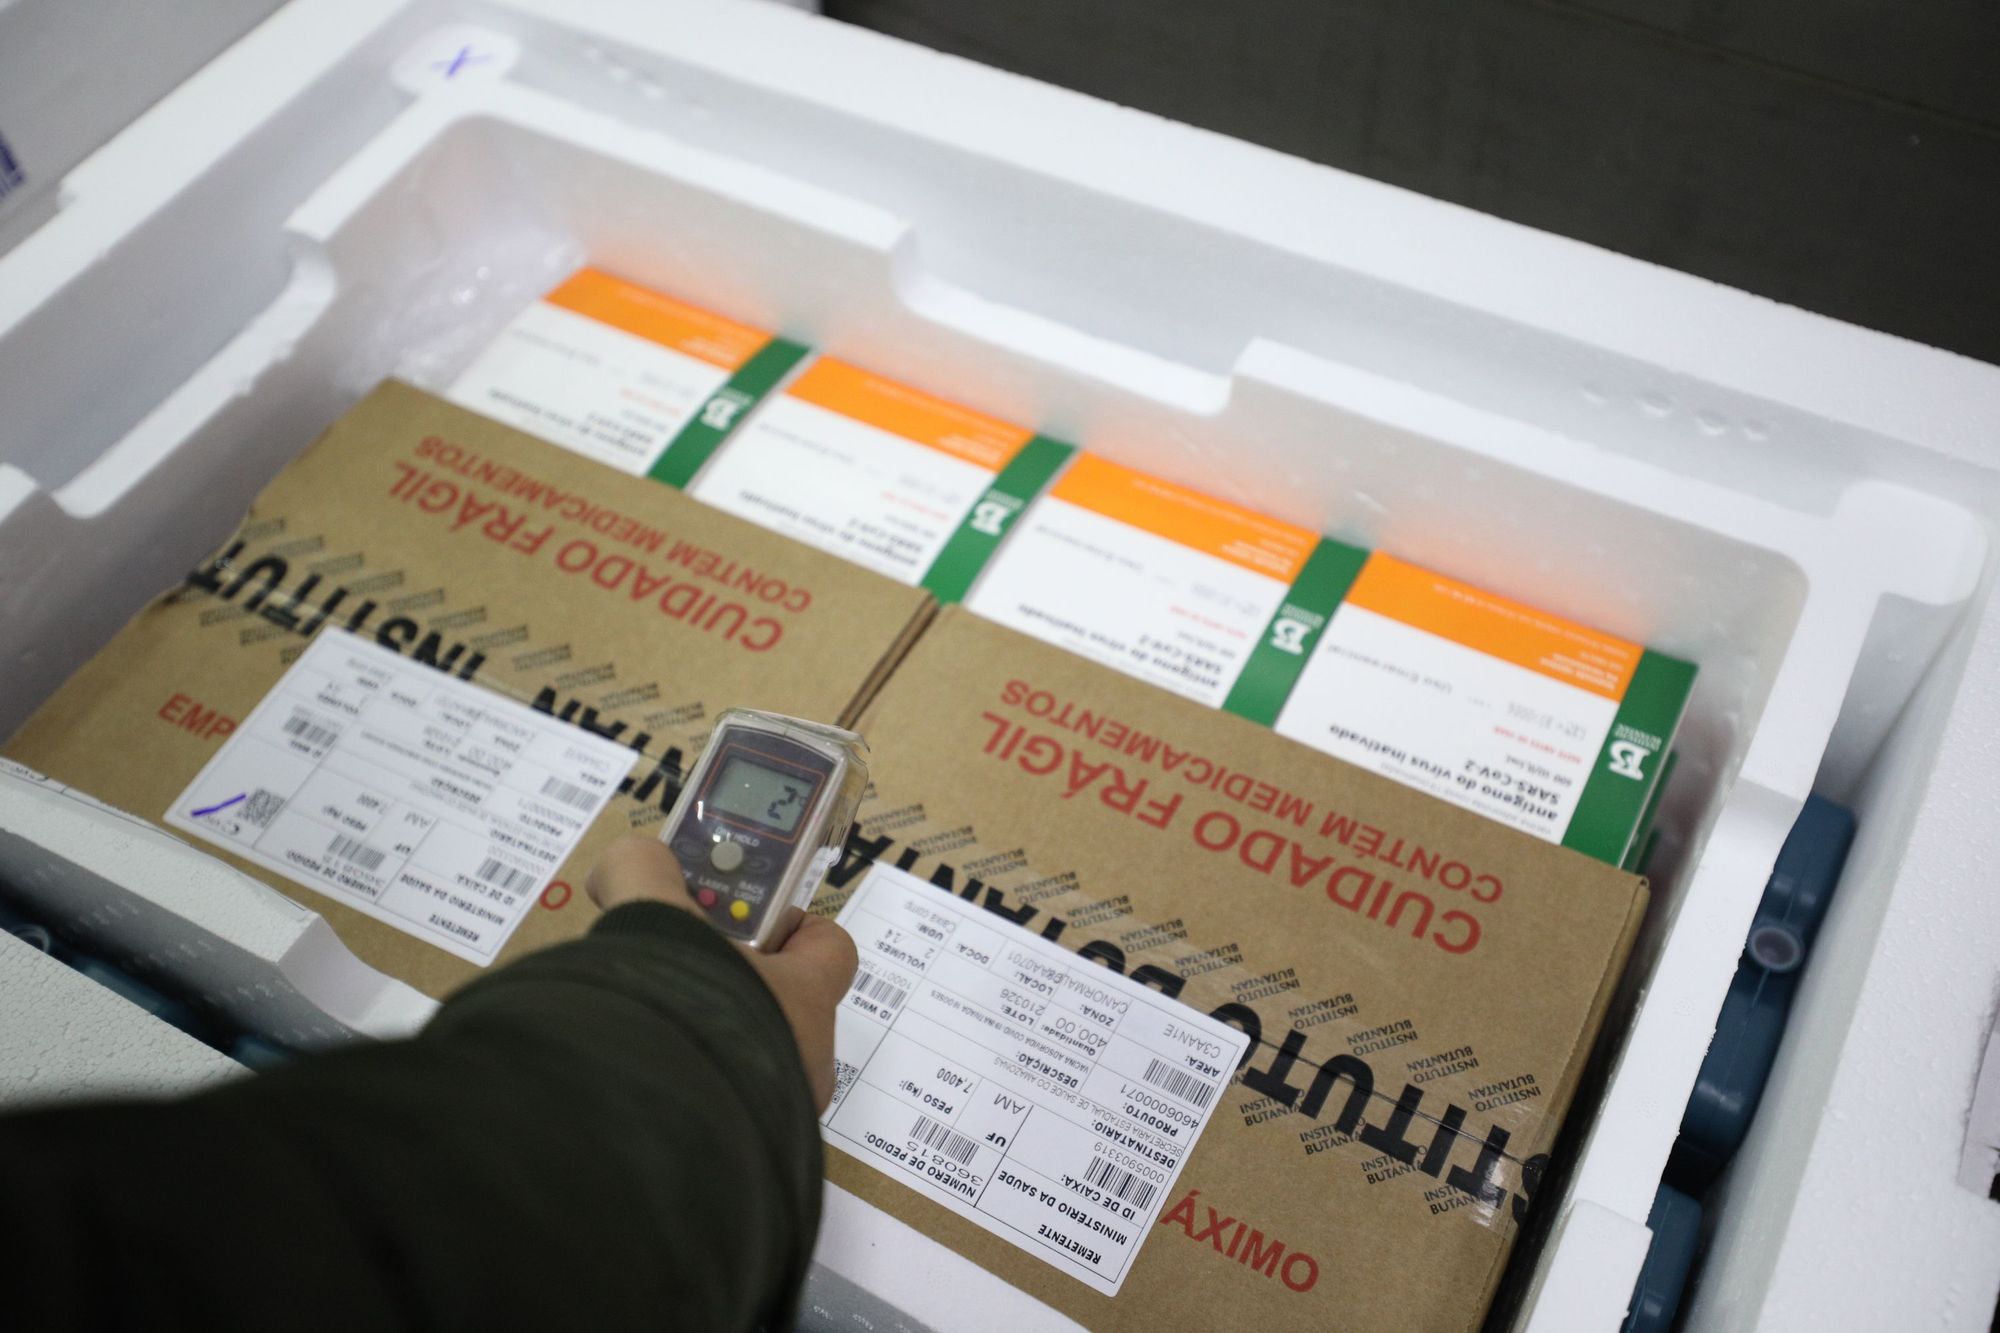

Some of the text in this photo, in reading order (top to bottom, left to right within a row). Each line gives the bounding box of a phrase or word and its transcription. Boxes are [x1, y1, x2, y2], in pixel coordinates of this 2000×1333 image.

[414, 436, 664, 552] MEDICAMENTOS
[389, 462, 782, 651] CUIDADO FRÁGIL
[666, 540, 811, 612] CONTÉM
[159, 693, 236, 741] EMP
[1326, 721, 1408, 764] inativado
[983, 712, 1184, 830] FRÁGIL
[1453, 773, 1478, 792] do
[1461, 756, 1562, 807] SARS-CoV-2
[1002, 682, 1503, 904] CONTÉM MEDICAMENTOS
[1478, 780, 1559, 825] antígeno
[697, 875, 730, 894] LASER
[1194, 812, 1482, 955] CUIDADO
[1119, 918, 1182, 942] BUTANTAN
[1123, 928, 1187, 953] INSTITUTO
[873, 938, 927, 970] VOLUMES:
[1173, 942, 1238, 967] BUTANTAN
[1179, 952, 1243, 977] INSTITUTO
[1012, 970, 1054, 996] LOCAL:
[1230, 967, 1295, 991] BUTANTAN
[1235, 977, 1300, 1003] INSTITUTO
[848, 993, 892, 1020] ID WMS:
[999, 986, 1046, 1016] 210326
[999, 1002, 1034, 1026] LOTE:
[1077, 1002, 1114, 1027] ZONA:
[1287, 992, 1353, 1018] BUTANTAN
[1293, 1003, 1357, 1028] INSTITUTO
[1039, 1022, 1096, 1057] Quantidade:
[1053, 1015, 1109, 1050] 400,00
[1162, 1023, 1222, 1060] C3AAN1E
[1345, 1018, 1412, 1045] BUTANTAN
[1351, 1029, 1417, 1055] INSTITUTO
[1013, 1049, 1079, 1089] DESCRIÇÃO:
[1183, 1054, 1220, 1078] AREA:
[1405, 1045, 1472, 1071] BUTANTAN
[1412, 1056, 1478, 1083] INSTITUTO
[934, 1064, 974, 1094] 7,4000
[1466, 1073, 1535, 1100] BUTANTAN
[896, 1076, 954, 1115] PESO (kg):
[992, 1091, 1025, 1117] AM
[1119, 1083, 1200, 1130] 4606000071
[1473, 1085, 1540, 1112] INSTITUTO
[1120, 1101, 1178, 1137] PRODUTO:
[984, 1129, 1007, 1147] UF
[1088, 1118, 1176, 1170] DESTINATÁRIO:
[1130, 1125, 1183, 1158] SECRETARIA
[862, 1129, 977, 1198] NUMERO DE PEDIDO:
[904, 1138, 984, 1187] 360815
[1092, 1140, 1165, 1184] 0005903319
[996, 1169, 1128, 1247] MINISTÉRIO DA SAÚDE
[1059, 1173, 1136, 1220] ID DE CAIXA:
[1037, 1222, 1102, 1264] REMETENTE
[1159, 1189, 1319, 1293] ÁXIMO
